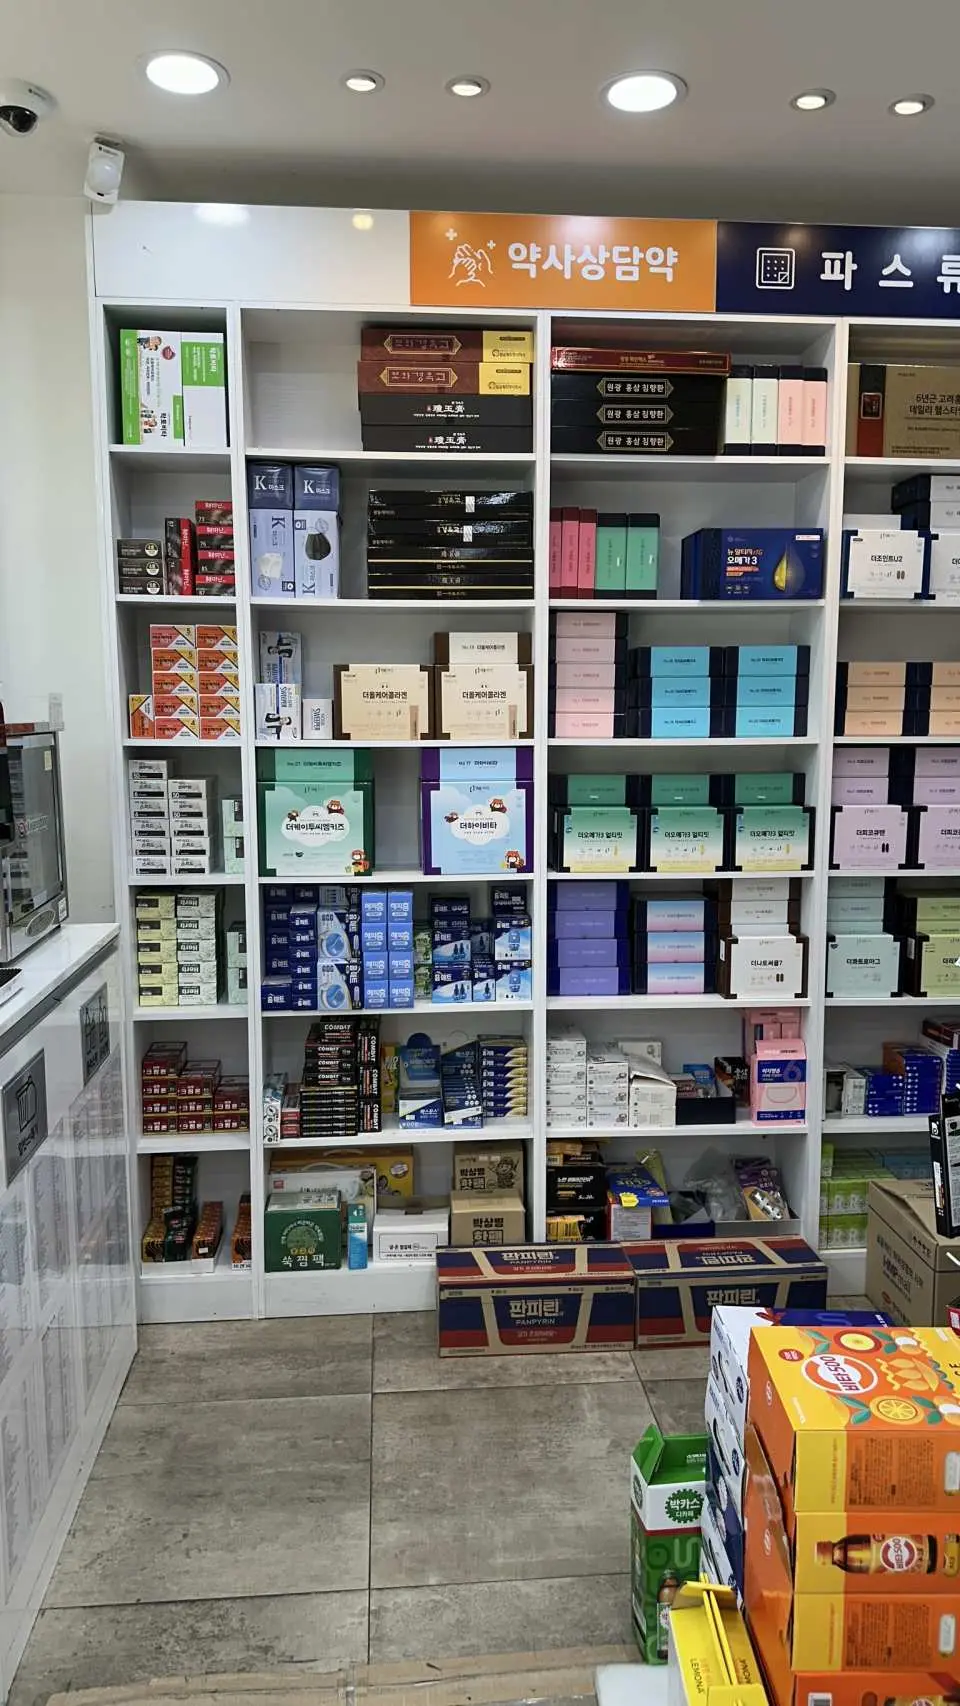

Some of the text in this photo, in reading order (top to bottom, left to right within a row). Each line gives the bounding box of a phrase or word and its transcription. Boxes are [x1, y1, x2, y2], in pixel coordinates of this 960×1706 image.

[508, 242, 679, 283] 약사상담약
[255, 475, 267, 491] K
[303, 479, 315, 494] K
[272, 516, 286, 529] K
[302, 582, 316, 595] K
[707, 1288, 756, 1306] 판피린
[509, 1299, 560, 1318] 판피린
[515, 1318, 556, 1326] PANPYRIN
[669, 1498, 701, 1511] 박카스
[689, 1657, 705, 1694] LEMONA
